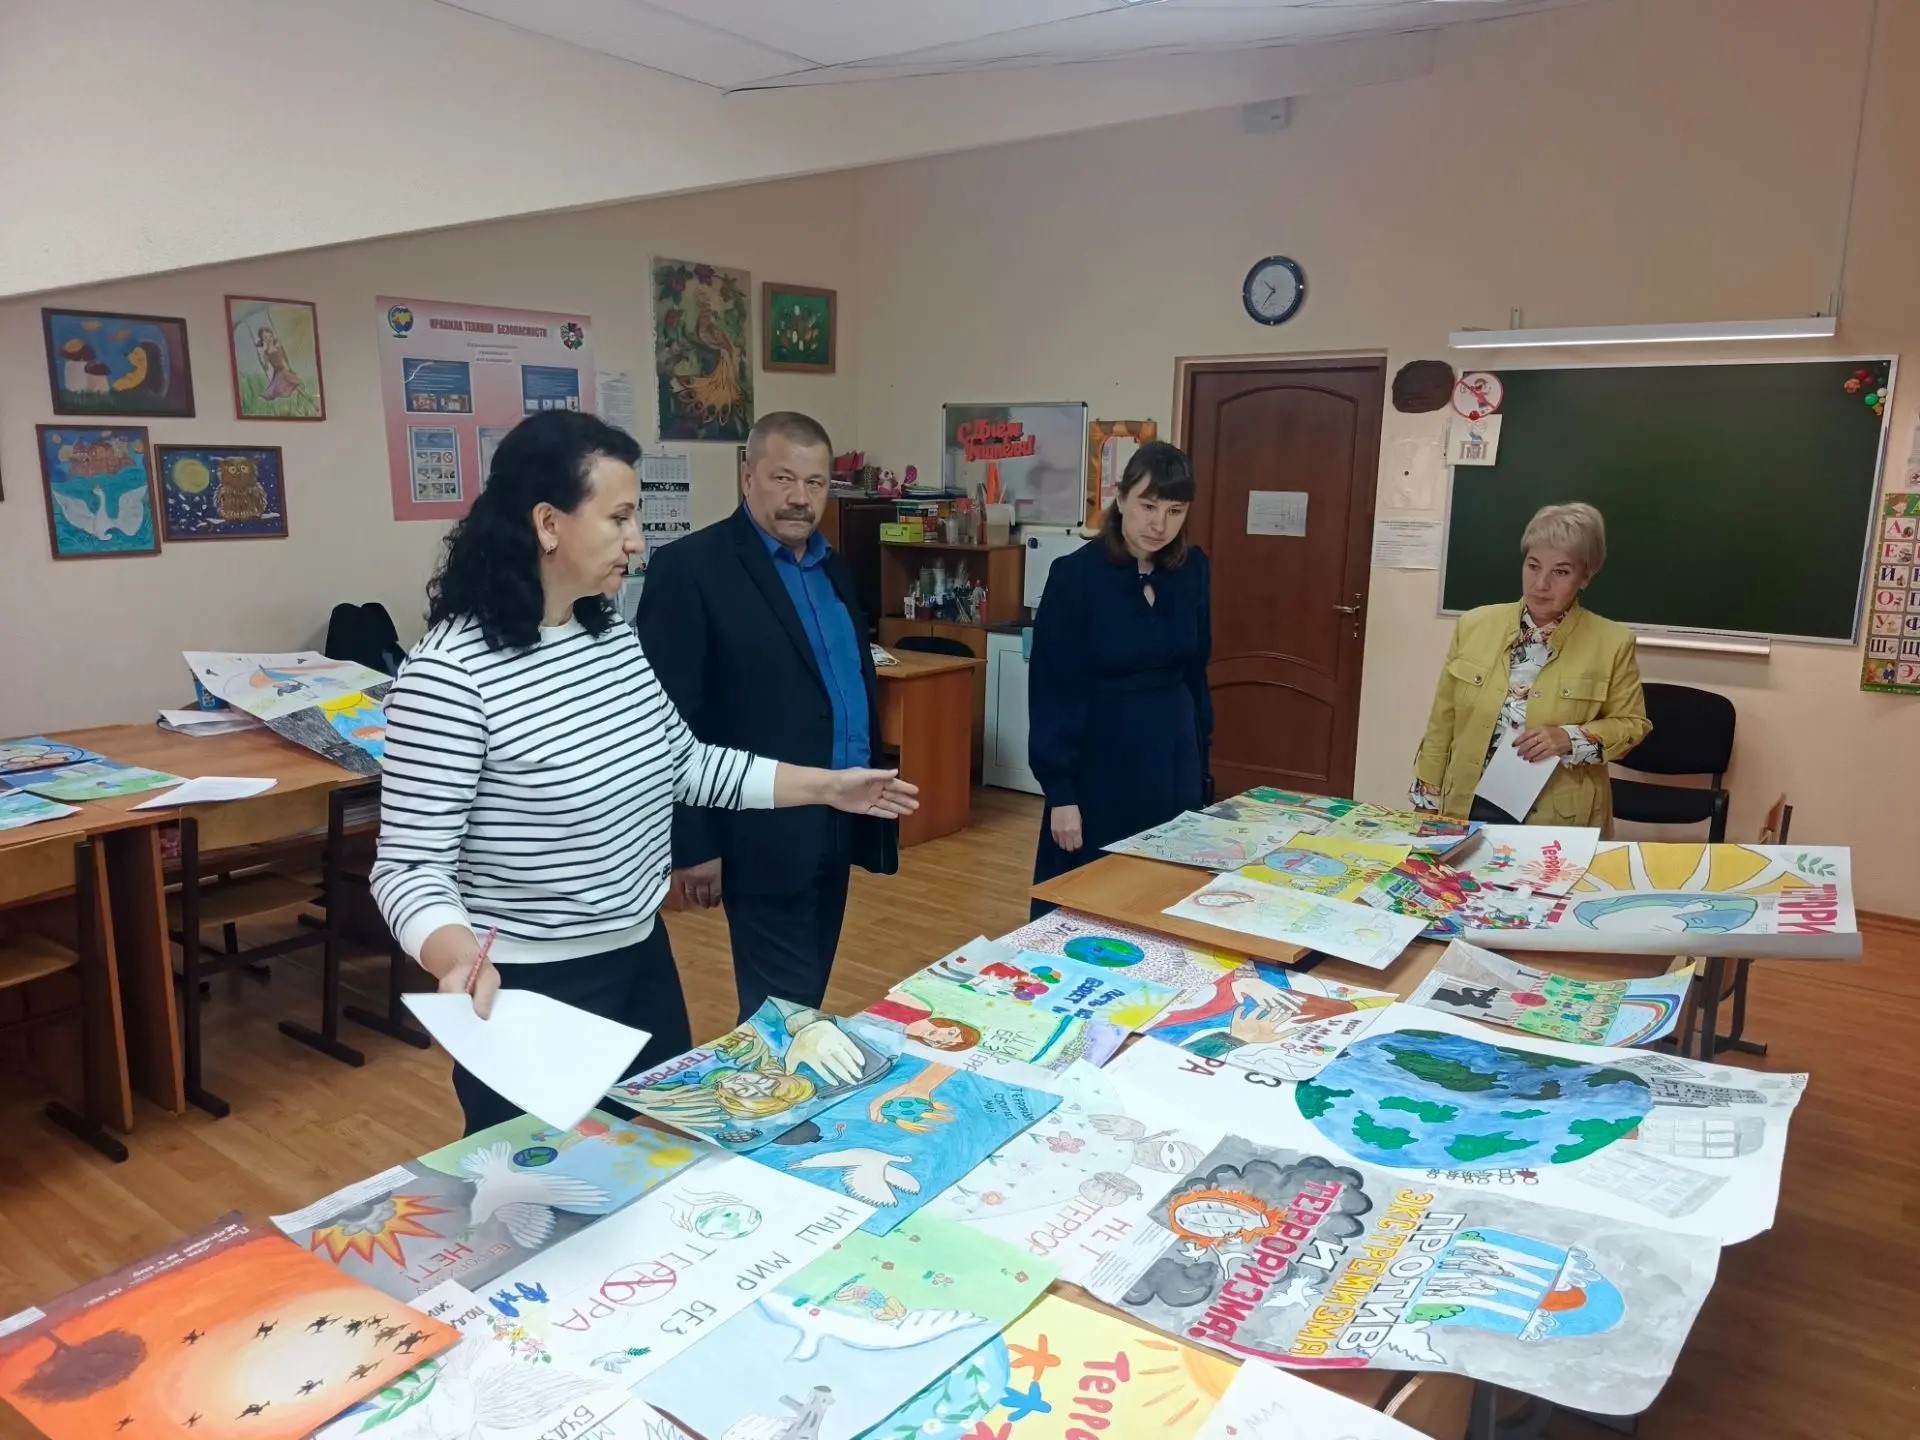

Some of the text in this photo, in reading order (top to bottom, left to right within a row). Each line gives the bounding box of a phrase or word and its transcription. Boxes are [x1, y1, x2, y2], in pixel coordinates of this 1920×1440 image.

[796, 1204, 859, 1249] НАШ
[735, 1248, 793, 1292] МИР
[1289, 1186, 1435, 1356] ЭКСТРЕМИЗМА
[1297, 1233, 1347, 1274] И
[1335, 1209, 1468, 1354] ПРОТИВ
[658, 1299, 718, 1337] БЕЗ
